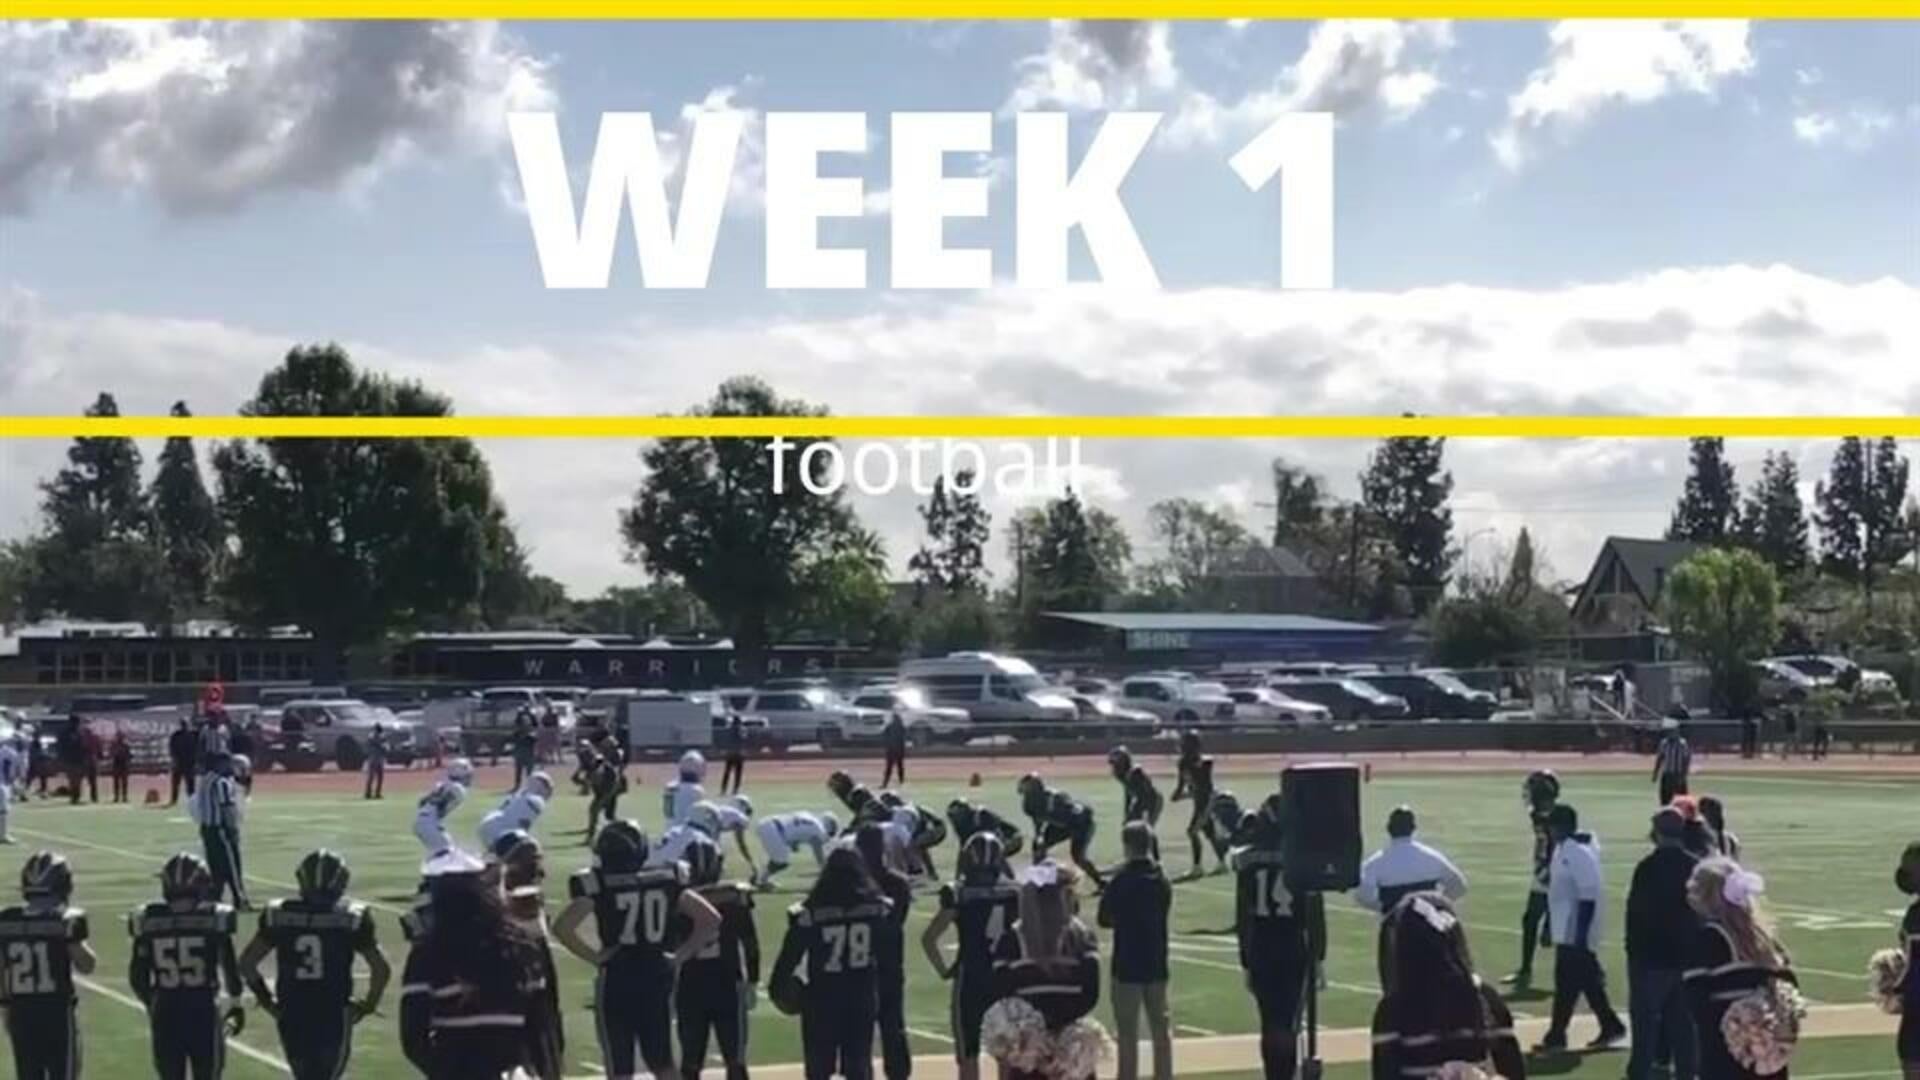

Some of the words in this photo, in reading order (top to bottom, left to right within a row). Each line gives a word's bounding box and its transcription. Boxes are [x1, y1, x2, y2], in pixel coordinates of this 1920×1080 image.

[615, 889, 668, 944] 70
[1256, 868, 1295, 917] 14
[8, 941, 56, 994] 21
[153, 935, 207, 988] 55
[294, 934, 325, 980] 3
[821, 922, 871, 973] 78
